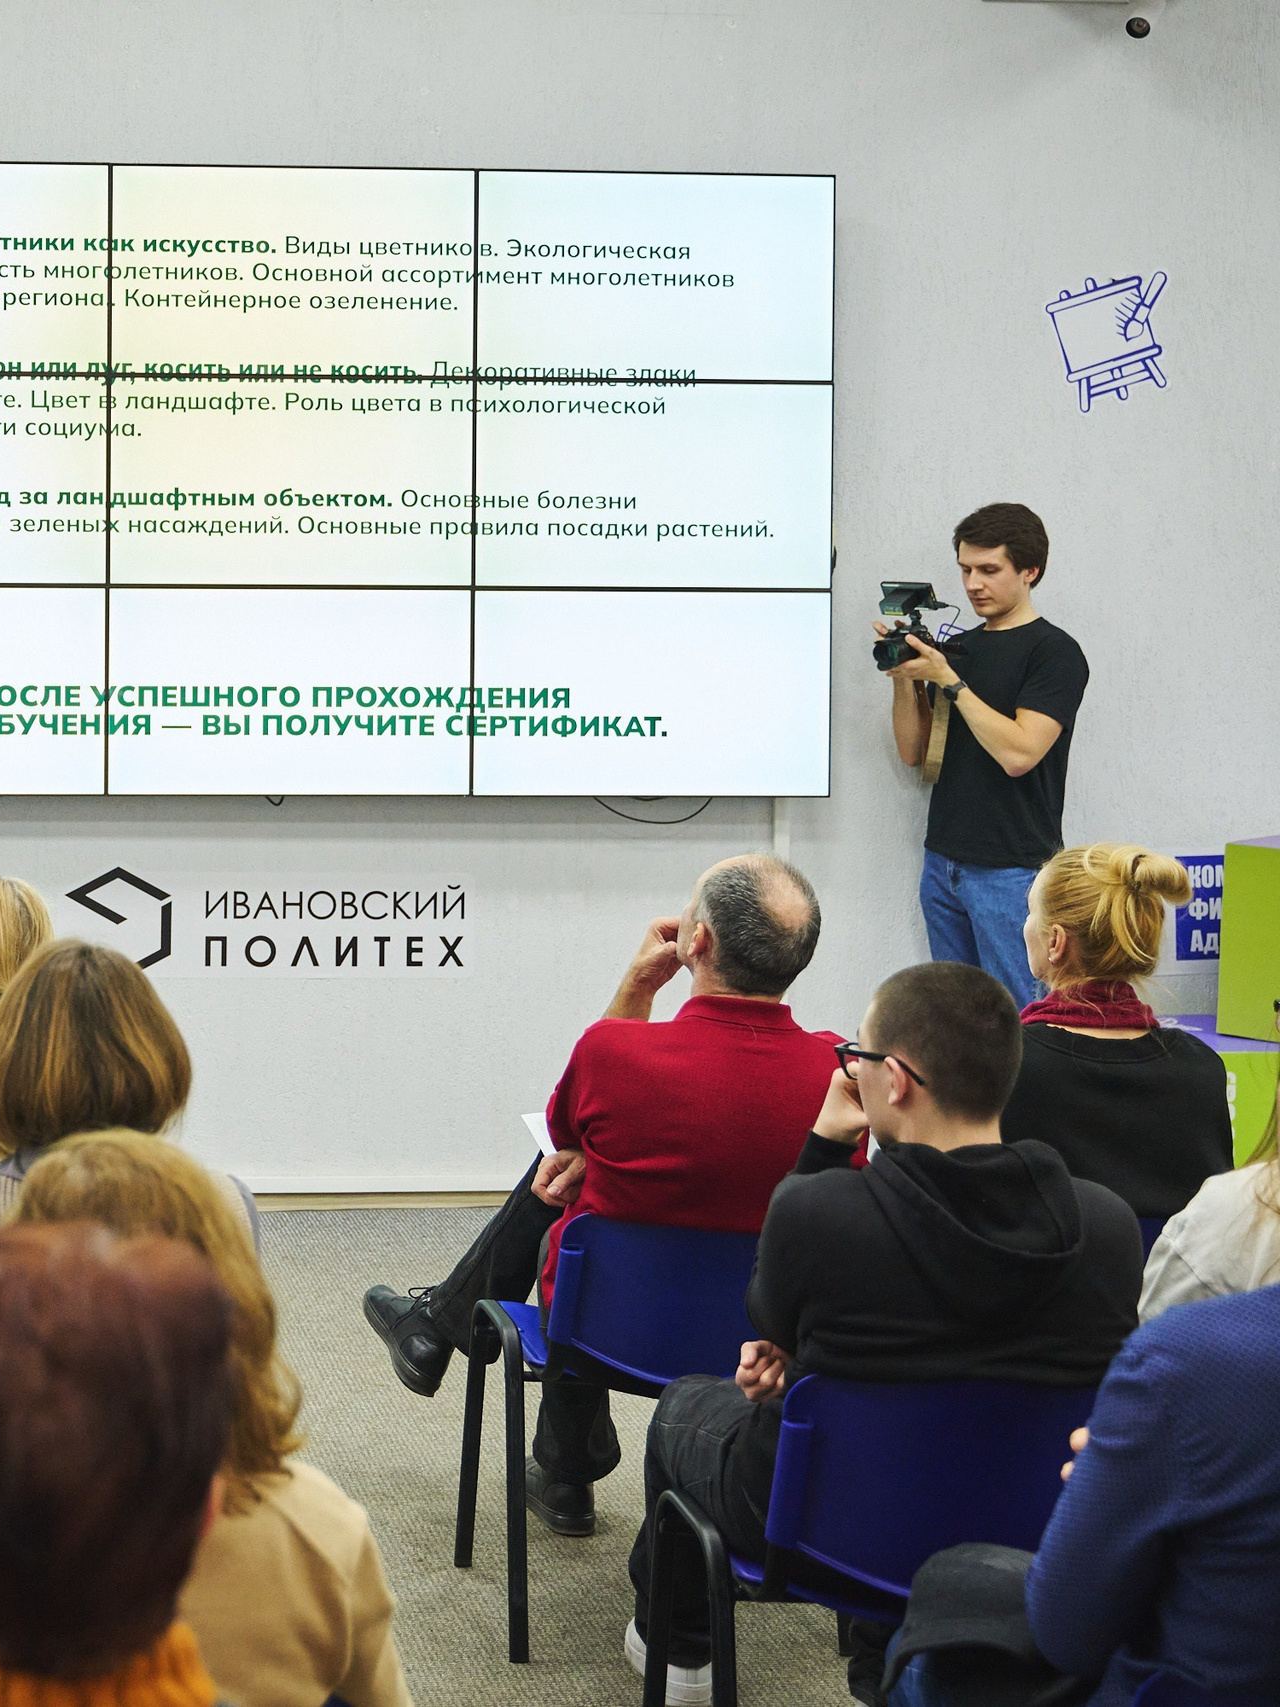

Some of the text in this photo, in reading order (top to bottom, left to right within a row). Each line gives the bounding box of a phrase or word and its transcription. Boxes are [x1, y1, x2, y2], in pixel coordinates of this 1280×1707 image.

[83, 238, 135, 252] как
[143, 239, 276, 258] искусство.
[285, 236, 350, 257] Виды
[359, 241, 498, 259] цветников.
[507, 239, 691, 260] Экологическая
[44, 264, 244, 282] многолетников.
[252, 263, 373, 283] Основной
[381, 268, 543, 288] ассортимент
[551, 271, 735, 288] многолетников
[3, 291, 115, 311] региона.
[125, 289, 301, 313] Контейнерное
[310, 295, 458, 311] озеленение.
[31, 361, 77, 381] или
[86, 362, 136, 386] луг,
[144, 363, 231, 382] косить
[239, 363, 284, 383] или
[294, 364, 322, 383] не
[331, 365, 423, 384] косить.
[430, 361, 617, 390] Декоративные
[626, 367, 696, 388] злаки
[31, 390, 91, 412] Цвет
[99, 395, 117, 408] в
[125, 391, 276, 415] ландшафте.
[285, 392, 343, 411] Роль
[352, 398, 421, 414] цвета
[430, 398, 442, 412] в
[451, 396, 666, 415] психологической
[25, 421, 142, 441] социума.
[20, 491, 48, 505] за
[56, 487, 255, 511] ландшафтным
[264, 488, 393, 507] объектом.
[401, 489, 529, 509] Основные
[537, 490, 637, 510] болезни
[9, 518, 120, 533] зеленых
[128, 516, 289, 536] насаждений.
[298, 516, 421, 535] Основные
[430, 521, 539, 540] правила
[548, 521, 648, 540] посадки
[657, 519, 775, 542] растений.
[90, 685, 301, 707] УСПЕШНОГО
[312, 686, 571, 713] ПРОХОЖДЕНИЯ
[202, 714, 250, 736] ВЫ
[262, 714, 435, 737] ПОЛУЧИТЕ
[445, 714, 668, 737] СЕРТИФИКАТ.
[205, 884, 465, 920] ИВАНОВСКИЙ
[205, 935, 464, 967] ПОЛИТЕХ
